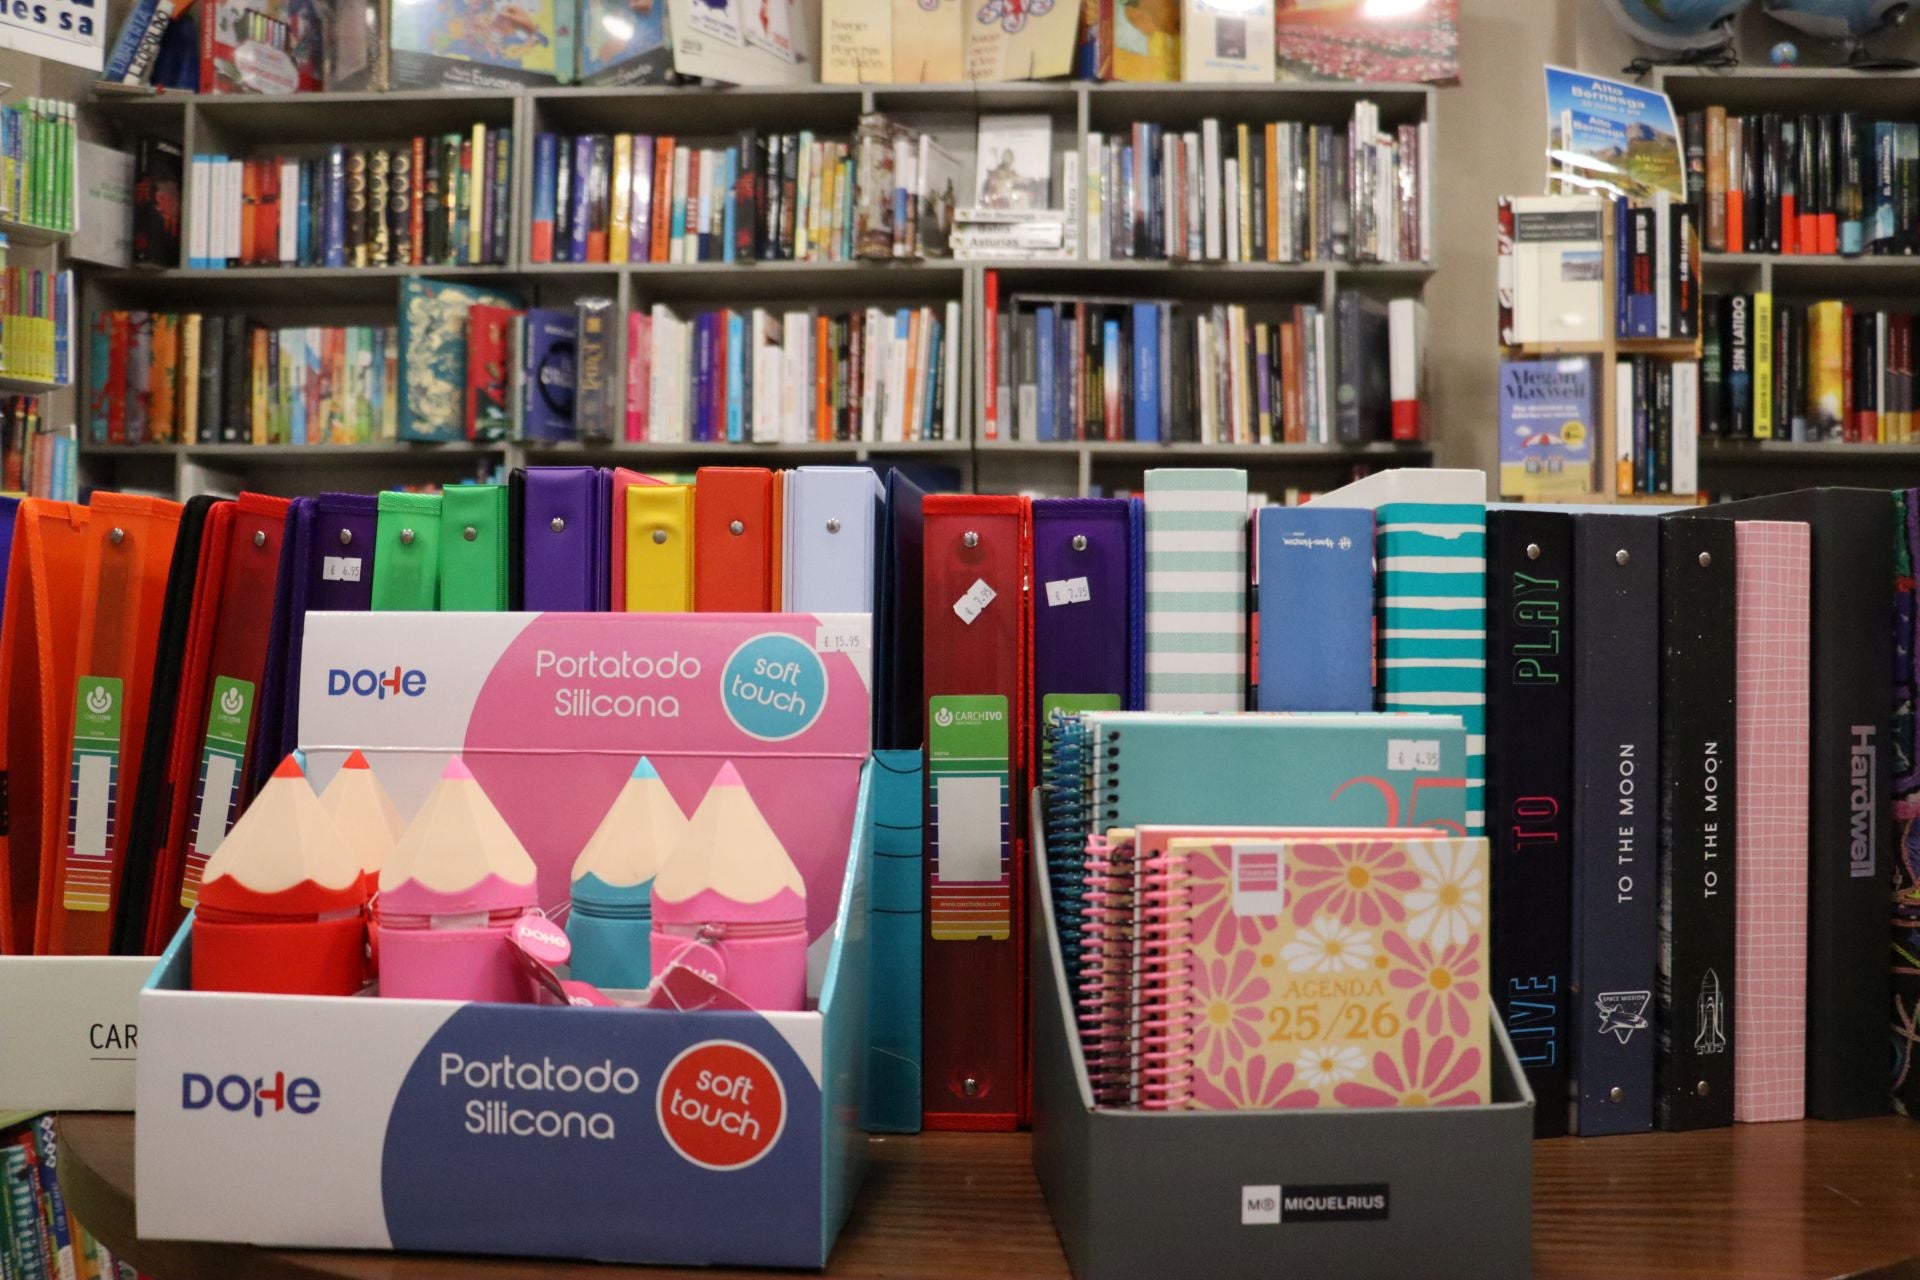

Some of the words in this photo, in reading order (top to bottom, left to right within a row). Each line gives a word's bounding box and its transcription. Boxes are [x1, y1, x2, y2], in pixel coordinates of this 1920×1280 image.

[59, 12, 94, 36] sa
[128, 9, 170, 78] LEOPOLDO
[1571, 85, 1645, 110] Bernesga
[1592, 81, 1623, 96] Alto
[970, 237, 1019, 247] Asturias
[1732, 296, 1746, 346] LATIDO
[1732, 348, 1746, 371] SIN
[1505, 384, 1586, 400] Maxwell
[1511, 369, 1578, 386] Megan
[834, 635, 861, 649] 15.95
[1513, 571, 1560, 686] PLAY
[536, 650, 702, 680] Portatodo
[753, 655, 803, 687] soft
[554, 688, 680, 719] Silicona
[730, 674, 807, 717] touch
[955, 711, 1003, 722] CARCHIVO
[1619, 744, 1635, 815] MOON
[1704, 742, 1718, 812] MOON
[1850, 725, 1876, 878] Hardwell
[1511, 795, 1559, 852] TO
[1618, 826, 1634, 865] THE
[1704, 822, 1718, 861] THE
[1618, 876, 1633, 904] TO
[1704, 871, 1718, 898] TO
[1281, 979, 1385, 999] AGENDA
[1267, 1000, 1400, 1043] 25/26
[440, 1053, 640, 1095] Portatodo
[696, 1068, 754, 1105] soft
[464, 1101, 616, 1140] Silicona
[671, 1088, 763, 1141] touch
[1284, 1195, 1386, 1212] MIQUELRIUS
